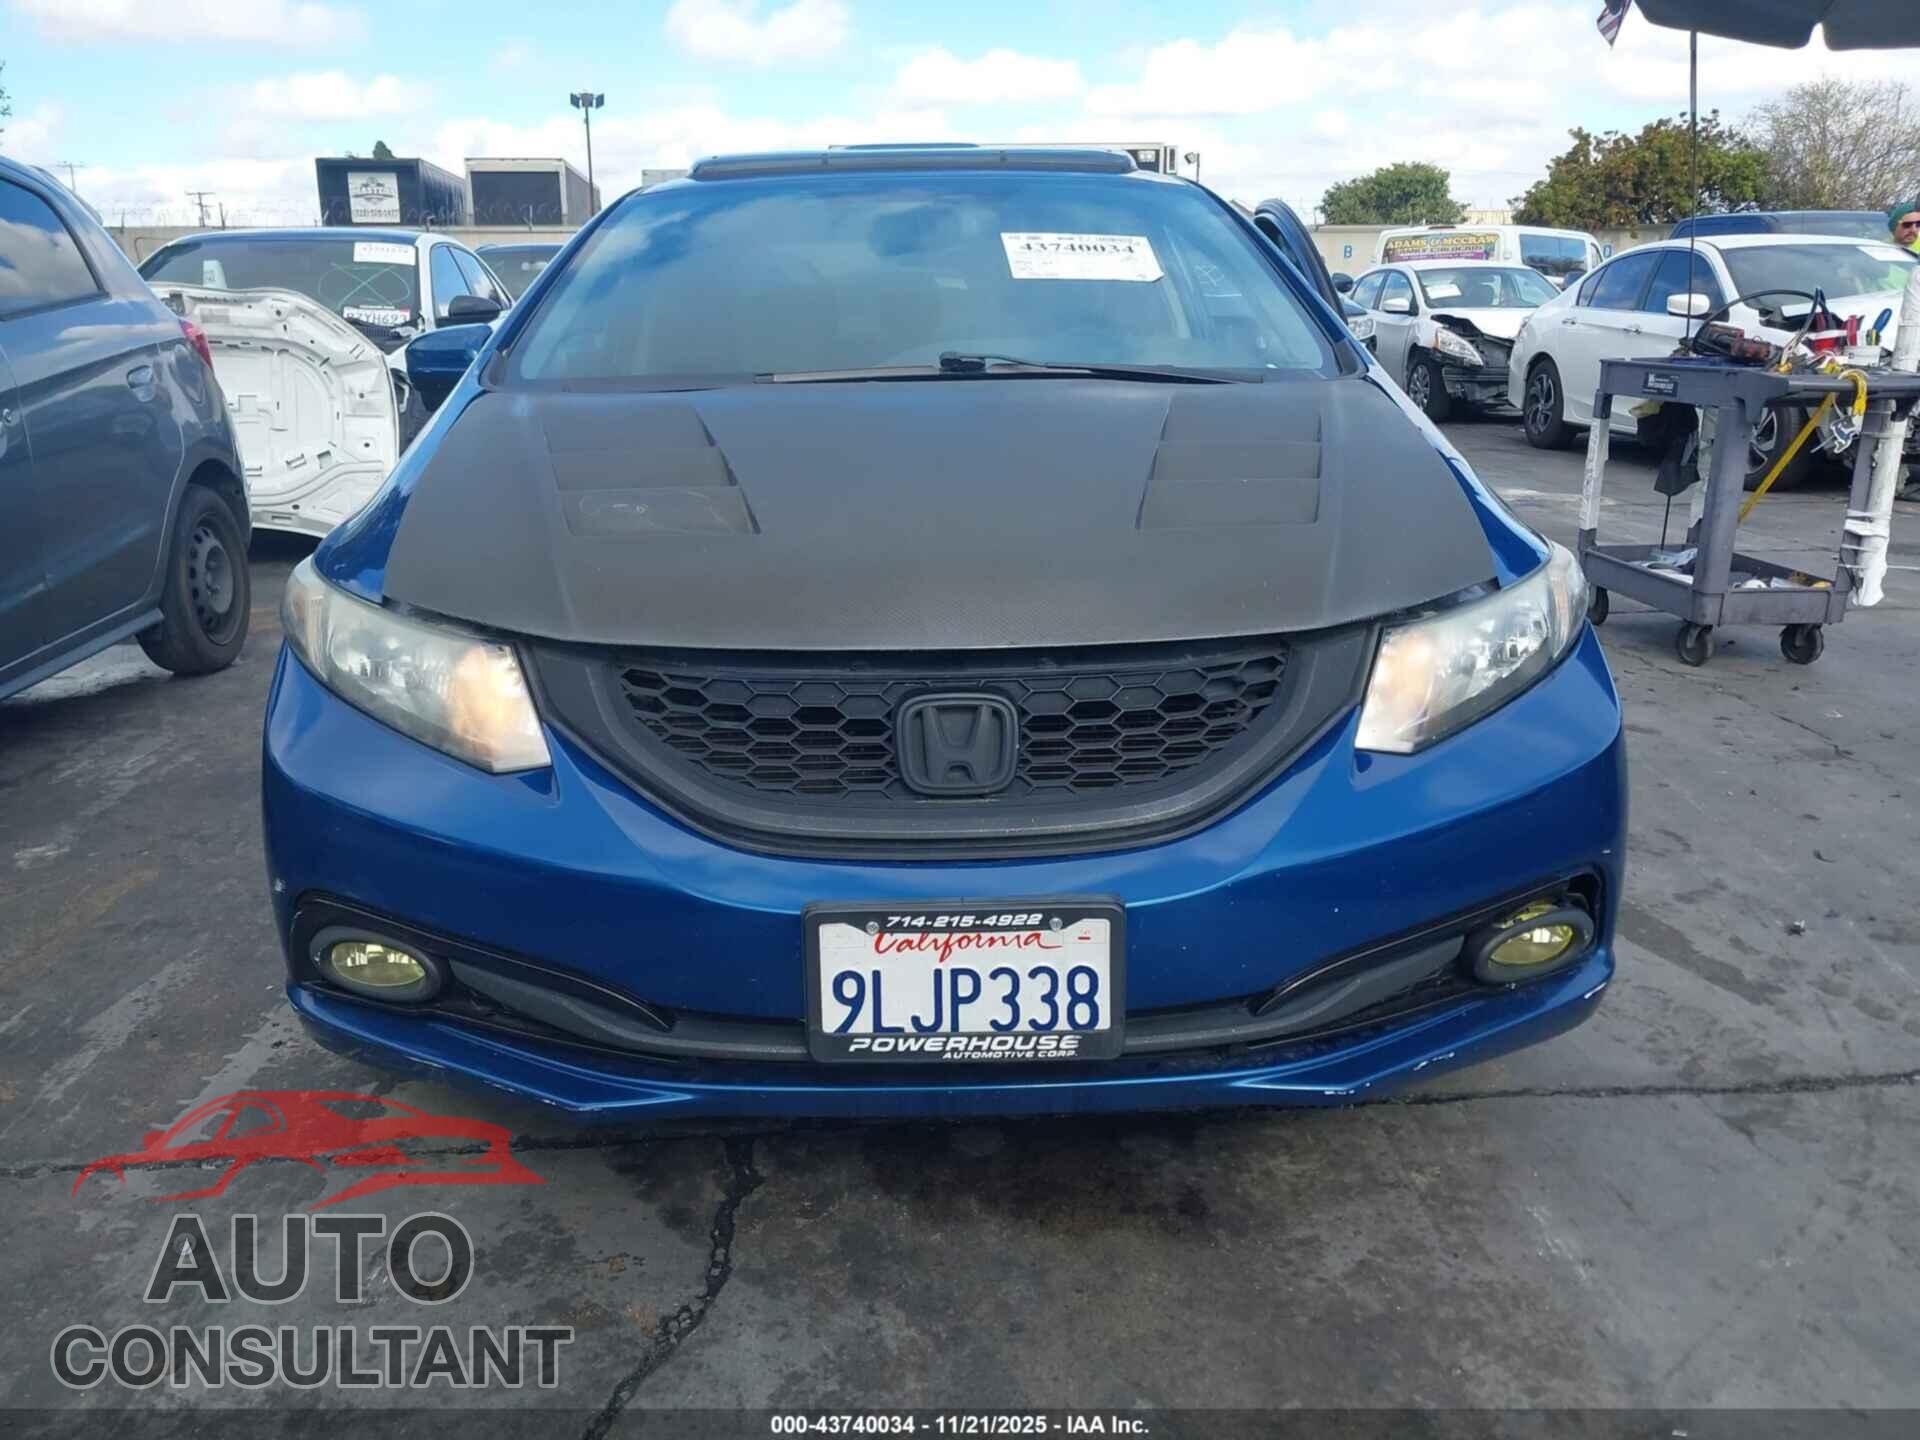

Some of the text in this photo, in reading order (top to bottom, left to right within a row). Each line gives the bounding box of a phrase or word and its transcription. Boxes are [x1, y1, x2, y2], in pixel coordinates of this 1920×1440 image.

[1343, 244, 1353, 258] B
[1386, 239, 1428, 250] ADAMS
[886, 913, 1043, 928] 714-215-4922
[872, 930, 1063, 963] California
[832, 965, 1100, 1033] 9LJP338
[849, 1035, 1082, 1053] POWERHOUSE
[942, 1050, 1035, 1059] AUTOMOTIVE
